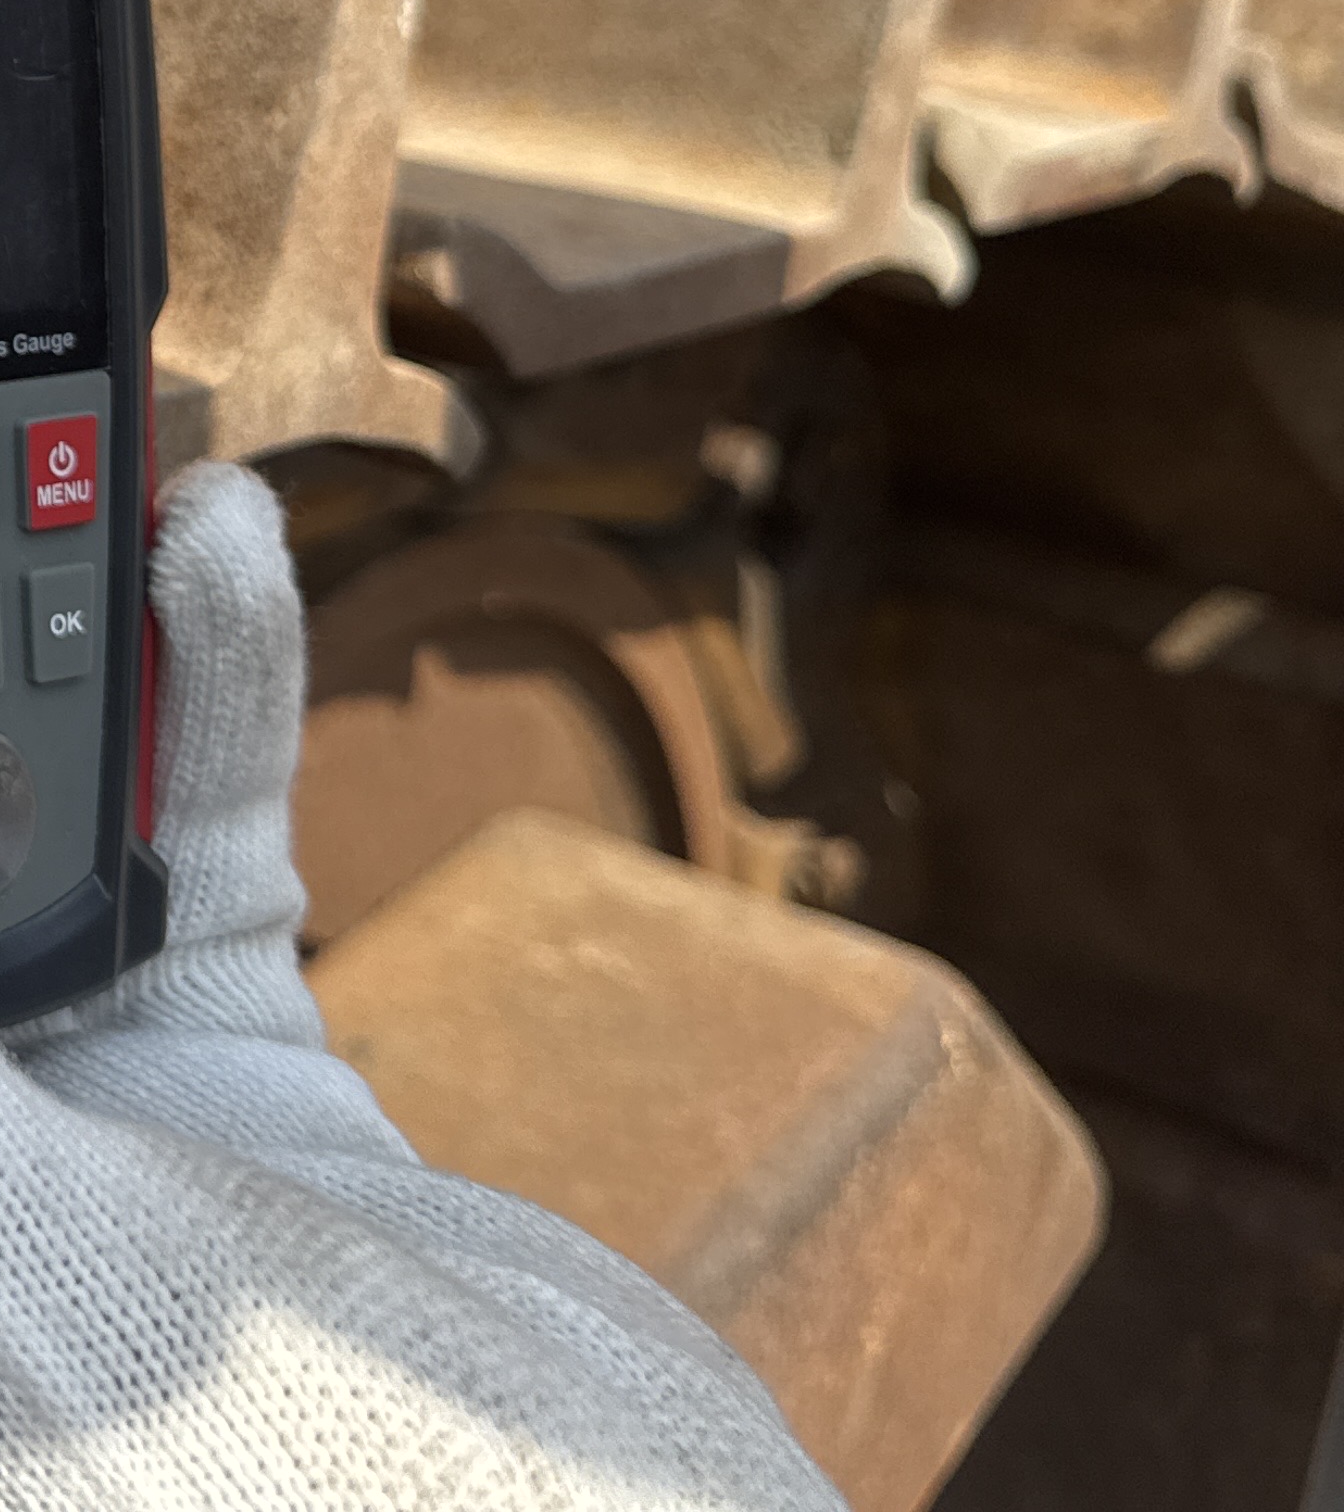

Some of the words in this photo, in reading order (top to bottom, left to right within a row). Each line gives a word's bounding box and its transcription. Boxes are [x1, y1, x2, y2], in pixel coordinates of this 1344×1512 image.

[13, 331, 75, 355] Gauge
[37, 479, 90, 507] MENU
[50, 611, 84, 637] OK
